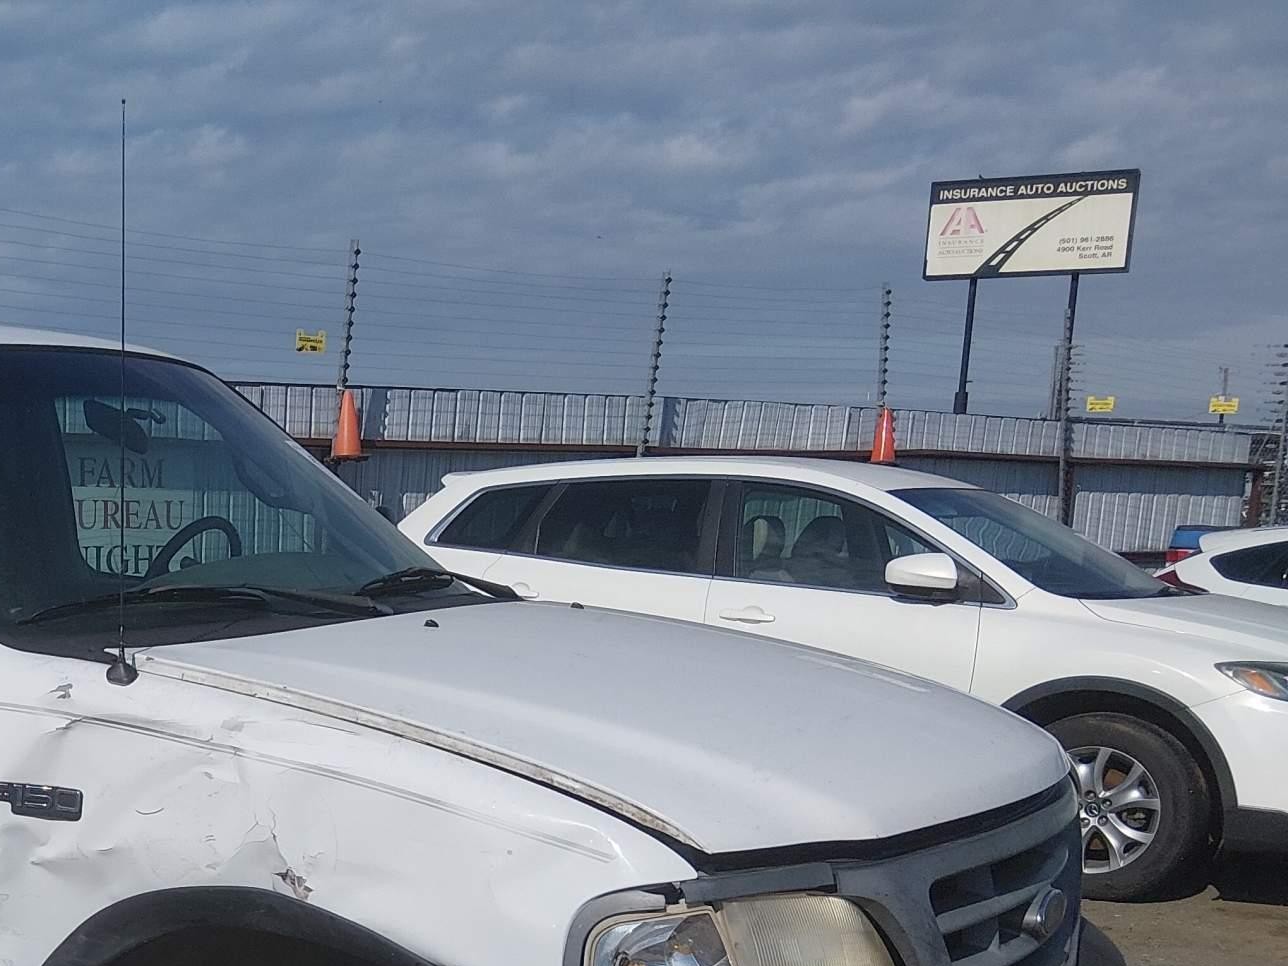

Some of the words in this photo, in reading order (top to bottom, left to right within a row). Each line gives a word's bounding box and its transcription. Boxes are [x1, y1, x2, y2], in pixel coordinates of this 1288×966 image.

[939, 185, 1015, 200] INSURANCE
[1018, 183, 1054, 196] AUTO
[1057, 178, 1128, 193] AUCTIONS
[78, 456, 166, 489] FARM
[74, 499, 185, 530] UREAU
